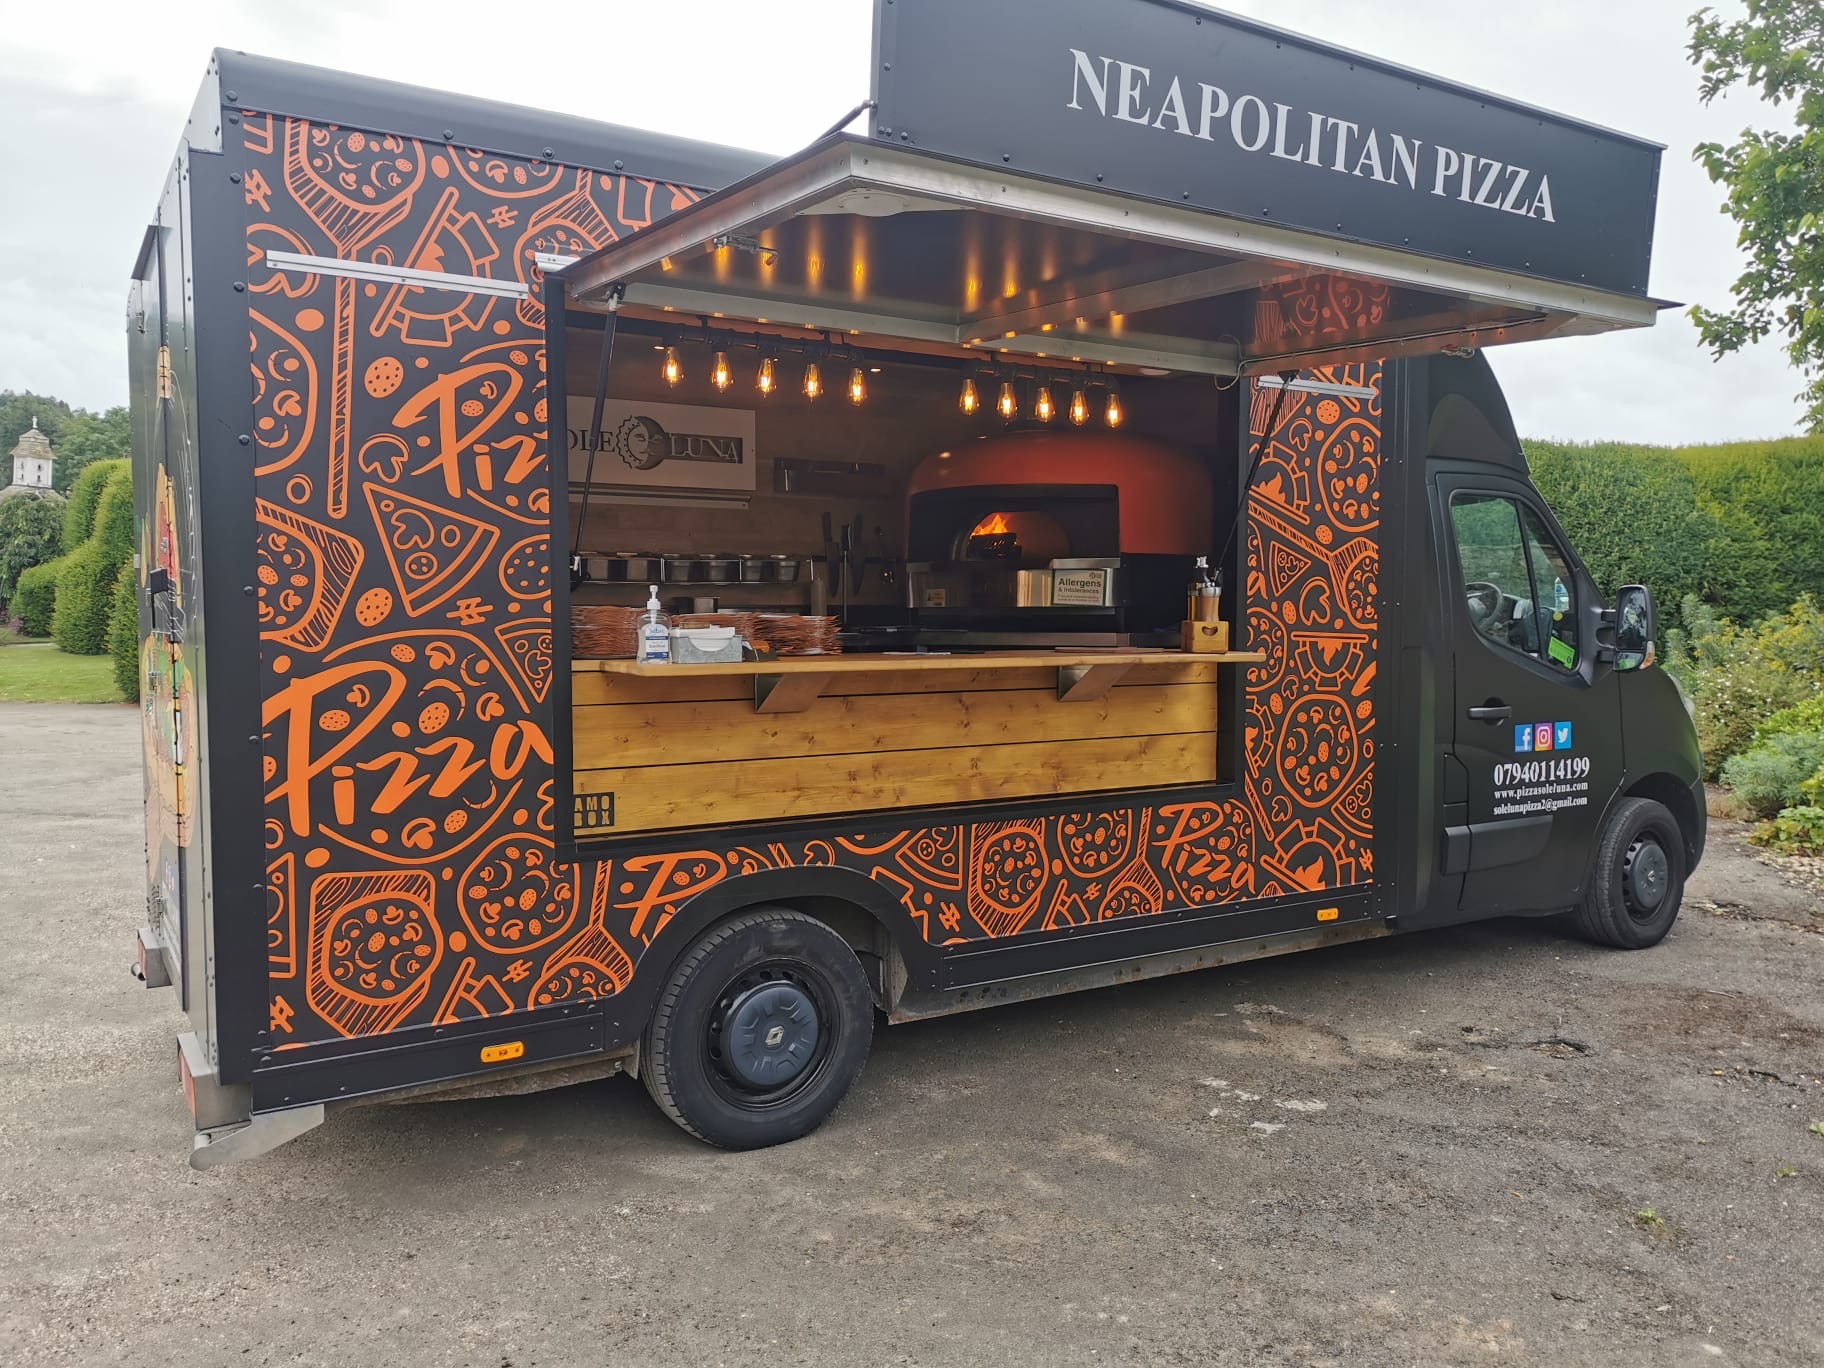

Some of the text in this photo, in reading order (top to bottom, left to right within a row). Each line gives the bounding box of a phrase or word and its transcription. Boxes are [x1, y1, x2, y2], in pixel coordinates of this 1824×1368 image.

[1066, 48, 1556, 223] NEAPOLITAN PIZZA
[670, 434, 740, 464] LUNA
[1058, 577, 1102, 589] Allergens
[262, 661, 554, 837] Pizza
[1494, 757, 1590, 786] 07940114199
[1494, 782, 1588, 800] www.pizzasoleluna.com
[1152, 801, 1256, 893] Pizza
